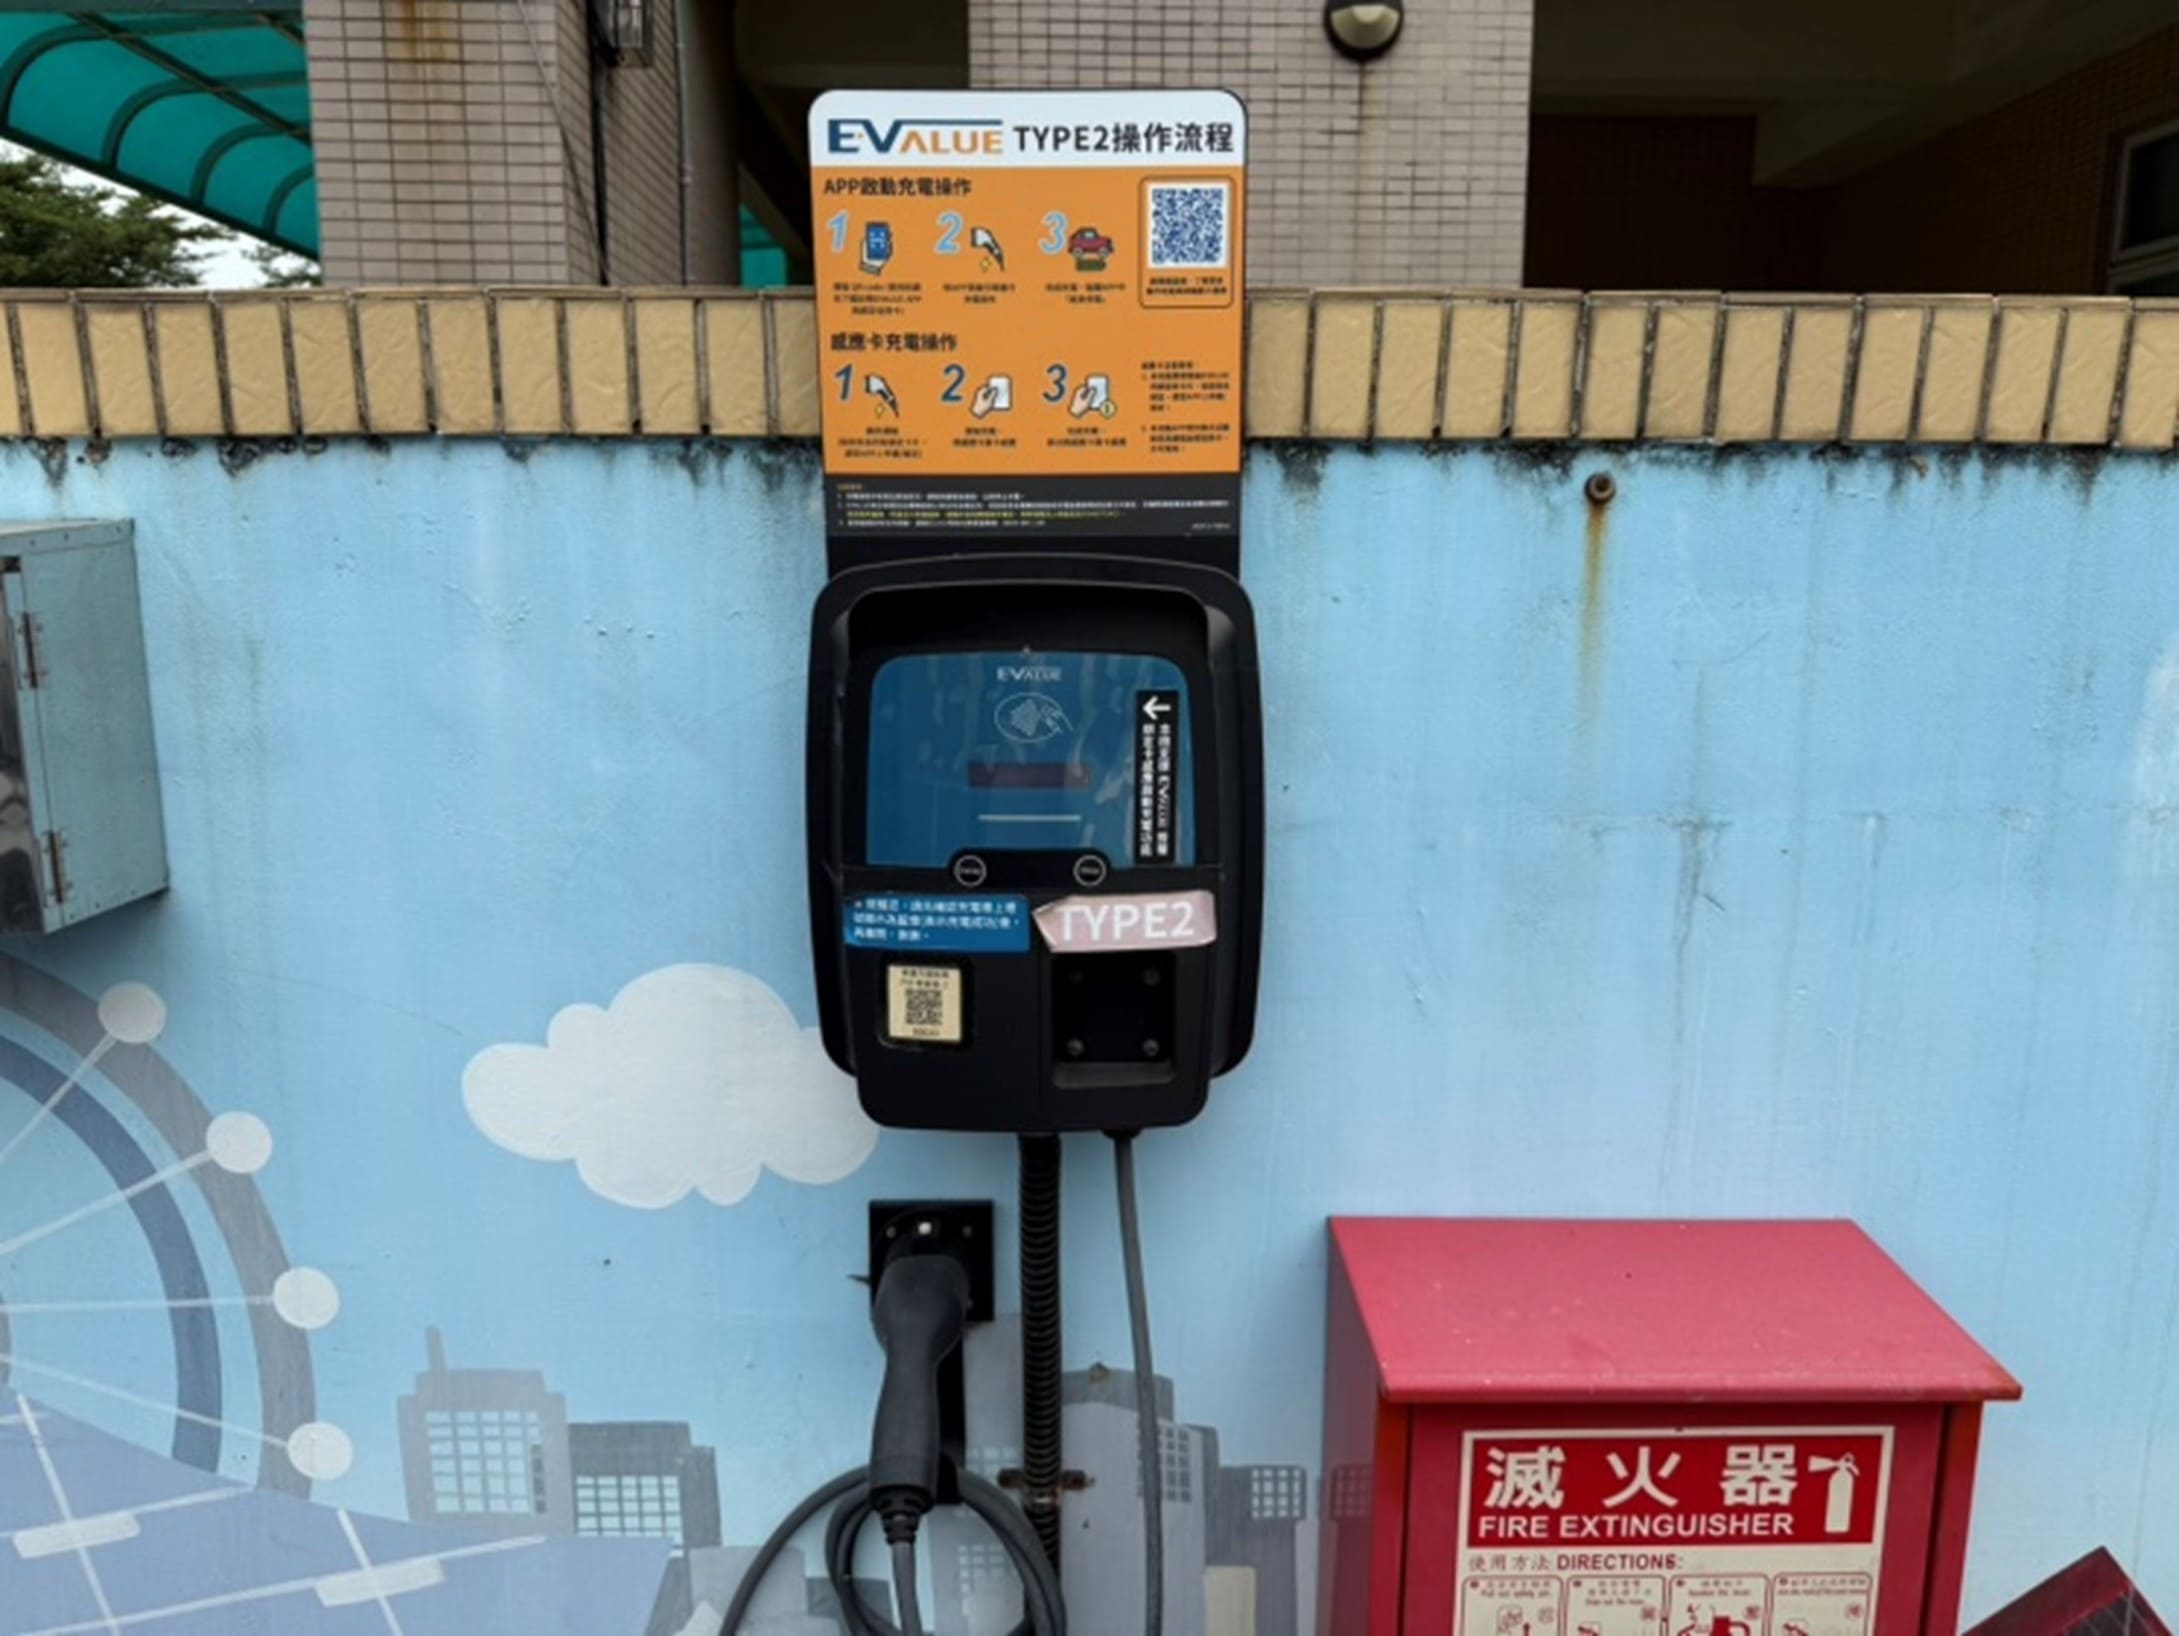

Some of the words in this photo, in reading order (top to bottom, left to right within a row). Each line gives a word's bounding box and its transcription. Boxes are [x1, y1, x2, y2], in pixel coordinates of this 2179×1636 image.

[1013, 122, 1234, 154] TYPE2操作流程
[827, 211, 848, 253] 1
[934, 211, 964, 254] 2
[1040, 211, 1068, 254] 3
[834, 363, 854, 401] 1
[941, 363, 965, 402] 2
[1043, 363, 1068, 402] 3
[1061, 902, 1195, 942] TYPE2
[1484, 1443, 1797, 1510] 滅火器
[1478, 1516, 1549, 1538] FIRE
[1560, 1513, 1794, 1538] EXTINGUISHER
[1469, 1554, 1549, 1572] 使用方法
